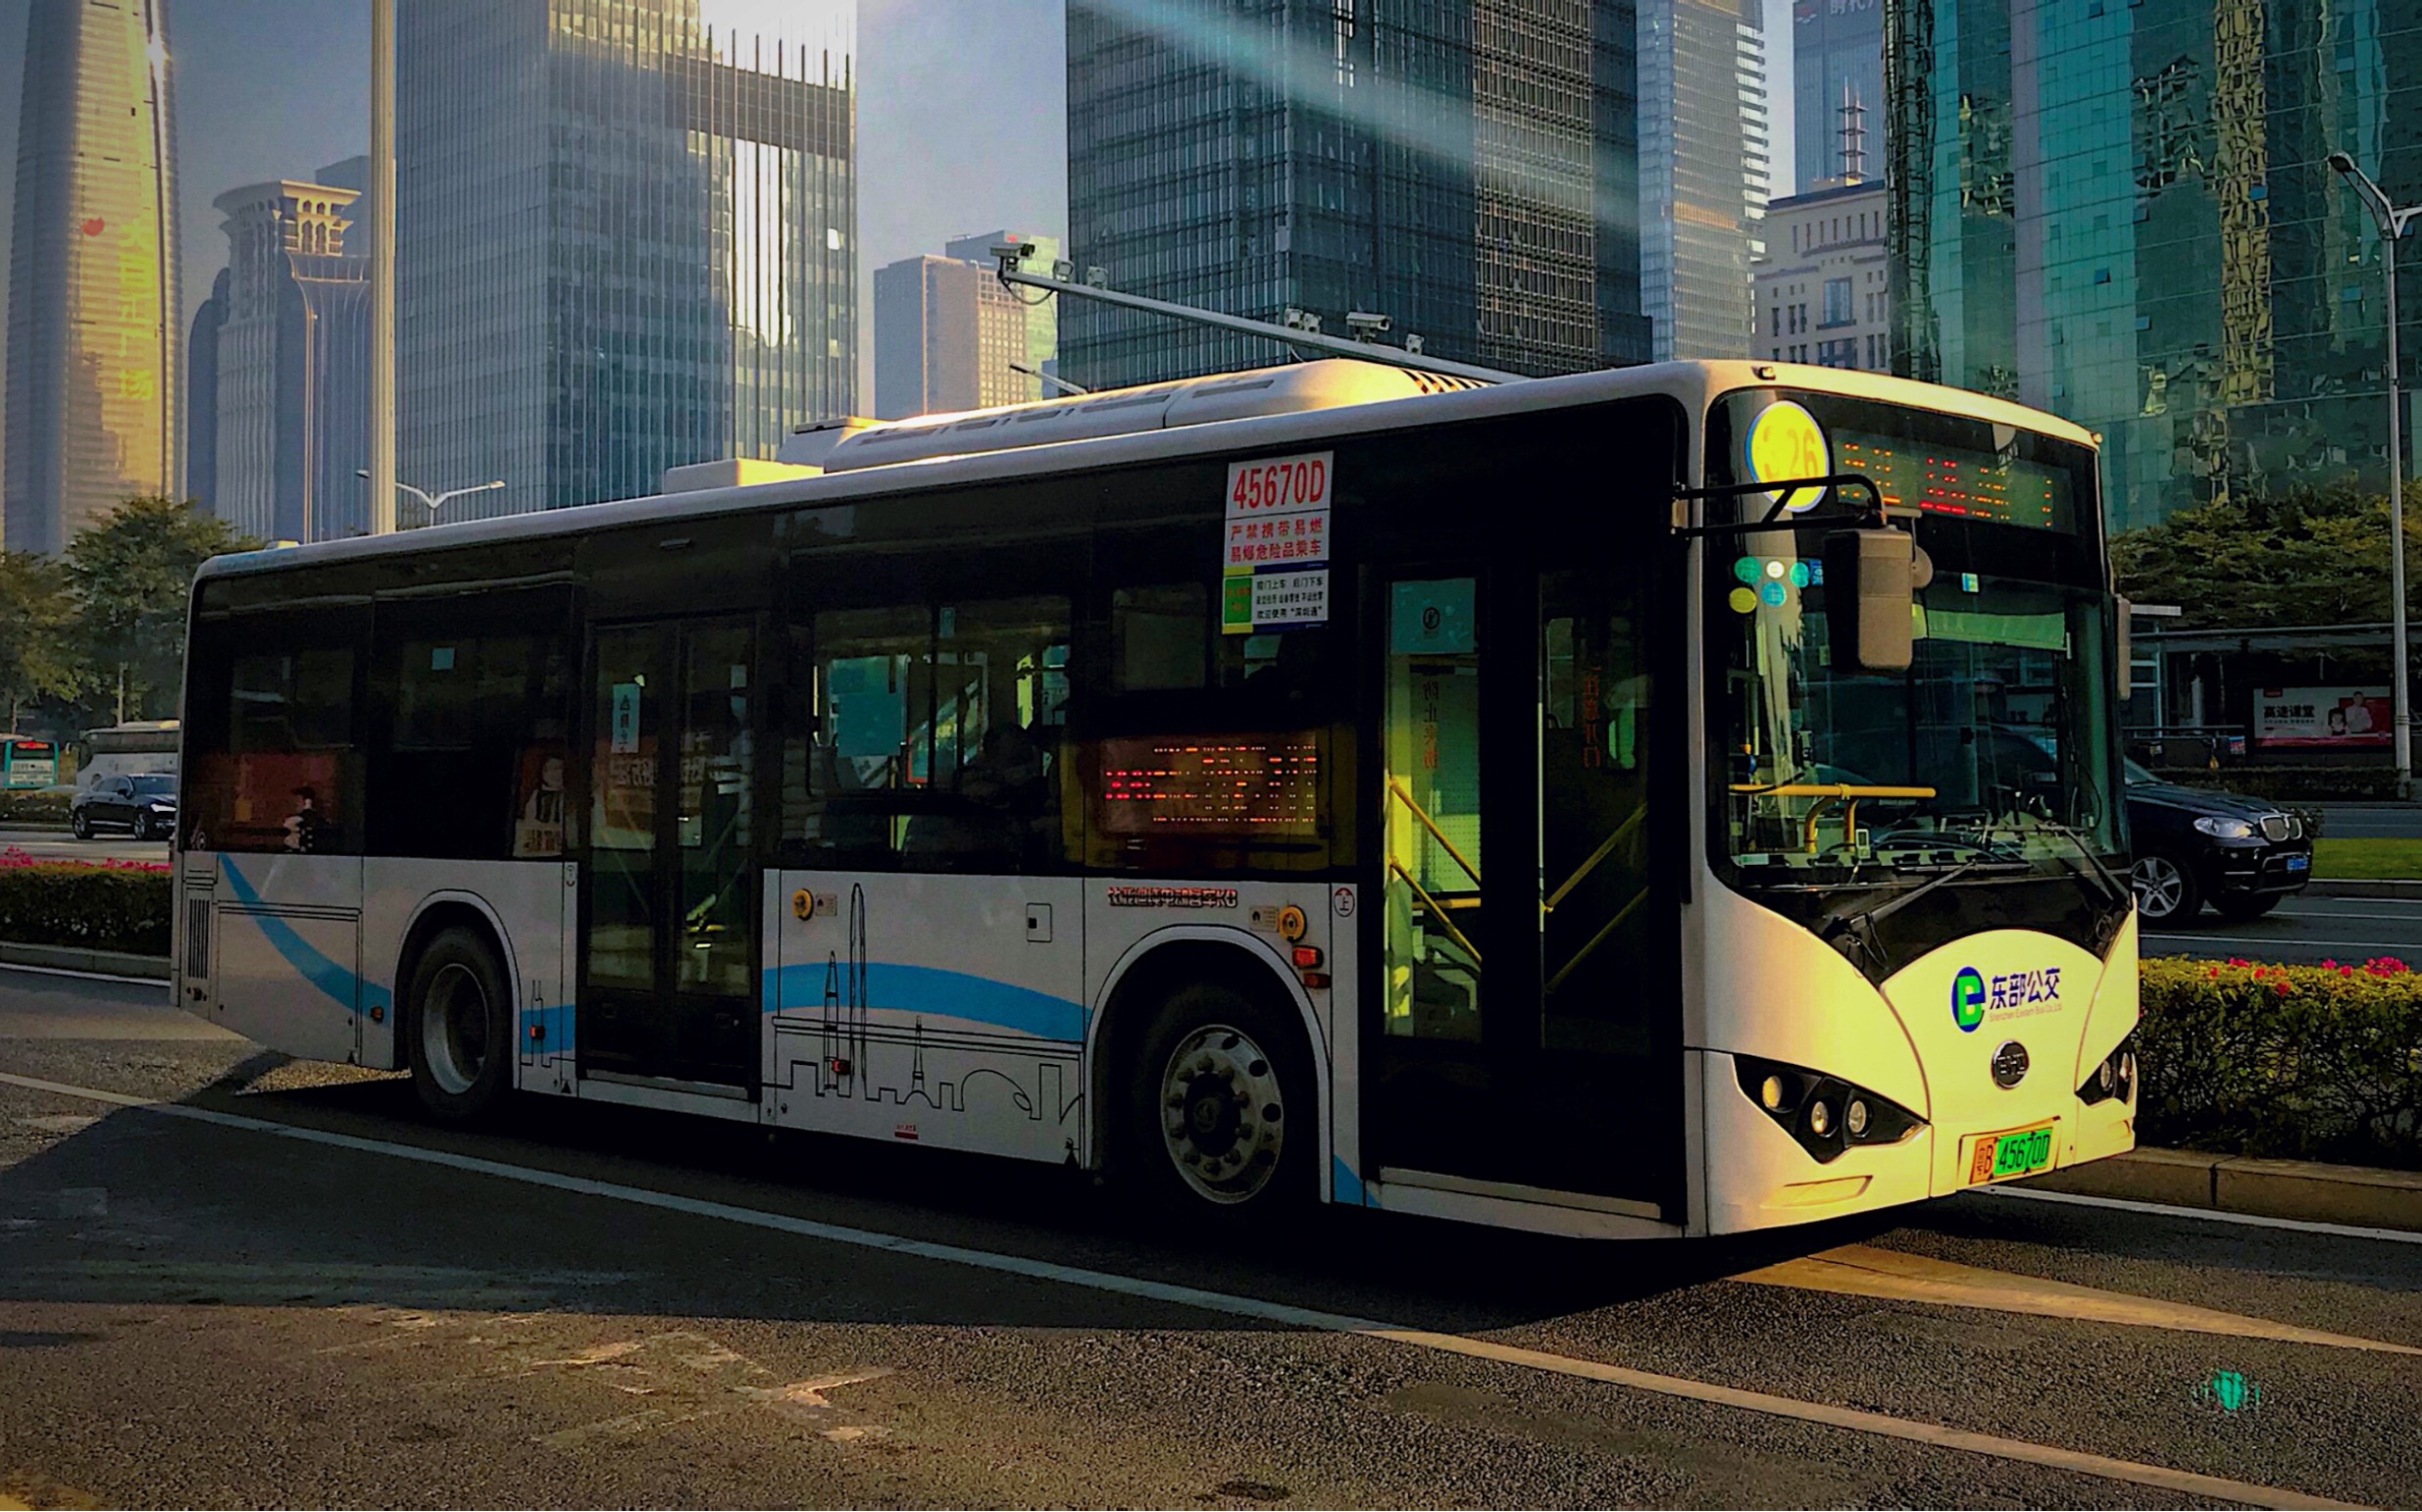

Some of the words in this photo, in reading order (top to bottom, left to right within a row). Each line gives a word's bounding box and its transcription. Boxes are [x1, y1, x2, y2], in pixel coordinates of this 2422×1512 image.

[1233, 460, 1325, 510] 45670D
[1231, 517, 1323, 541] 严禁携带易燃
[1230, 539, 1322, 563] 易爆危险品乘车
[1990, 968, 2061, 1010] 东部公交
[1998, 1134, 2050, 1171] 45670D
